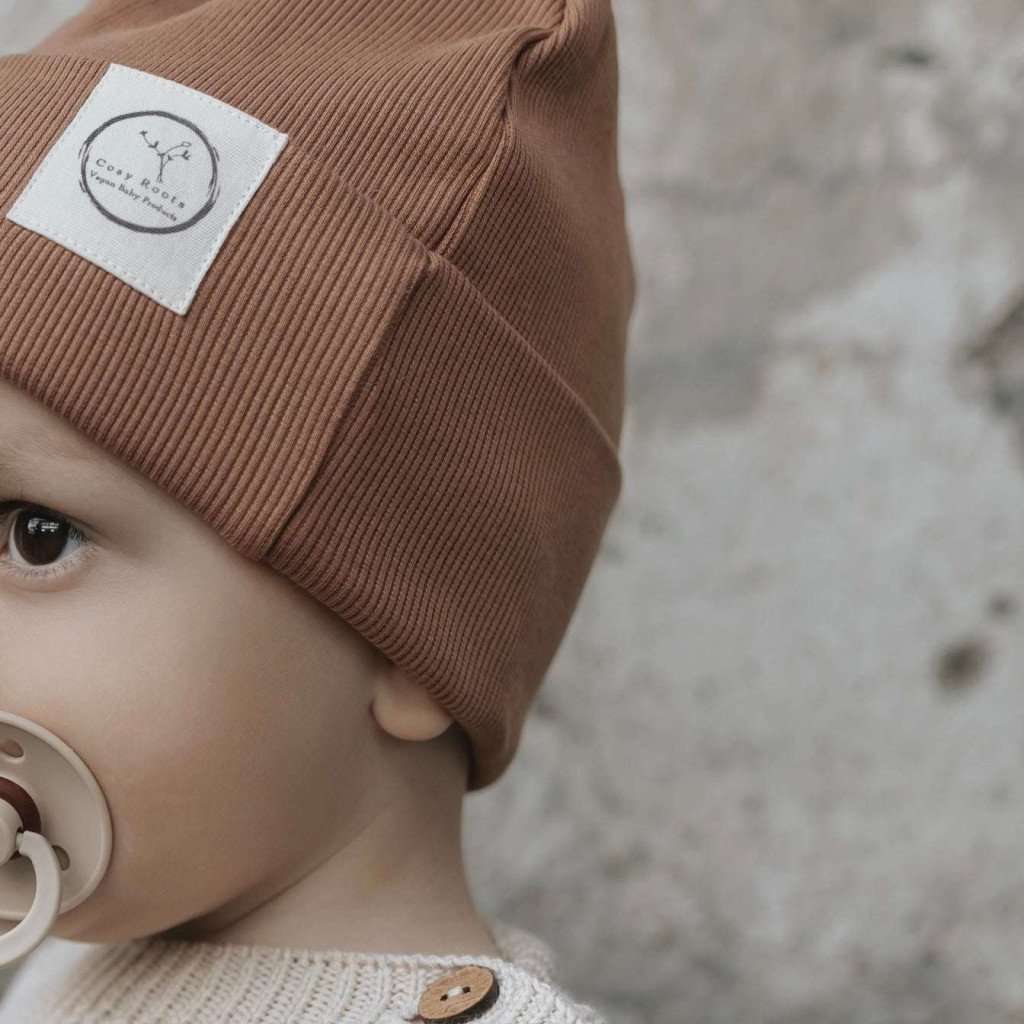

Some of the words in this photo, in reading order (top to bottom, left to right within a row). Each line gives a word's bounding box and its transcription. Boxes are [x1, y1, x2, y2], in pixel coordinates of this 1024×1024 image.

[89, 169, 116, 188] Vegan
[117, 183, 141, 201] Baby
[142, 196, 177, 222] Products
[140, 177, 186, 209] Roots
